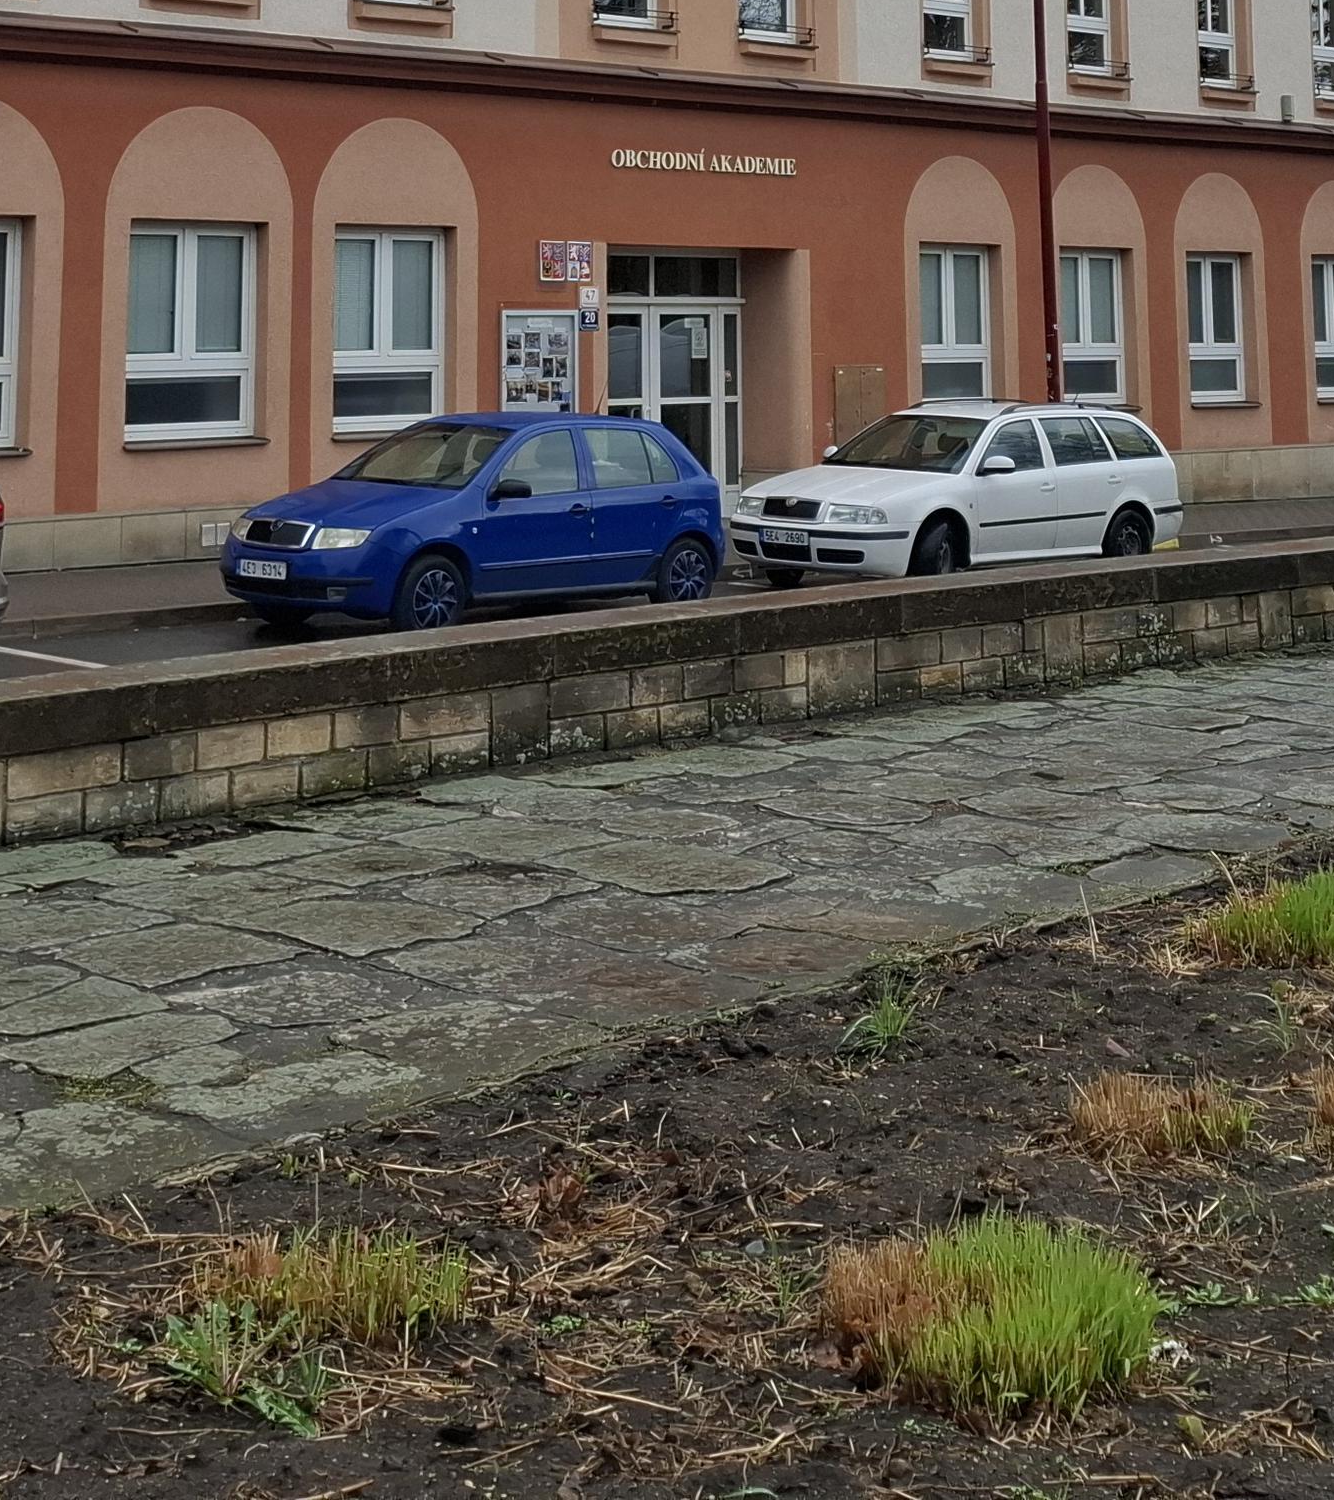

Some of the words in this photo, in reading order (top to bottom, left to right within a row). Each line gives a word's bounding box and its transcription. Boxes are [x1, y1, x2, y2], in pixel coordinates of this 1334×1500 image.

[611, 148, 705, 172] OBCHODNÍ
[709, 154, 797, 176] AKADEMIE
[585, 312, 596, 323] 20
[262, 562, 282, 577] 6314
